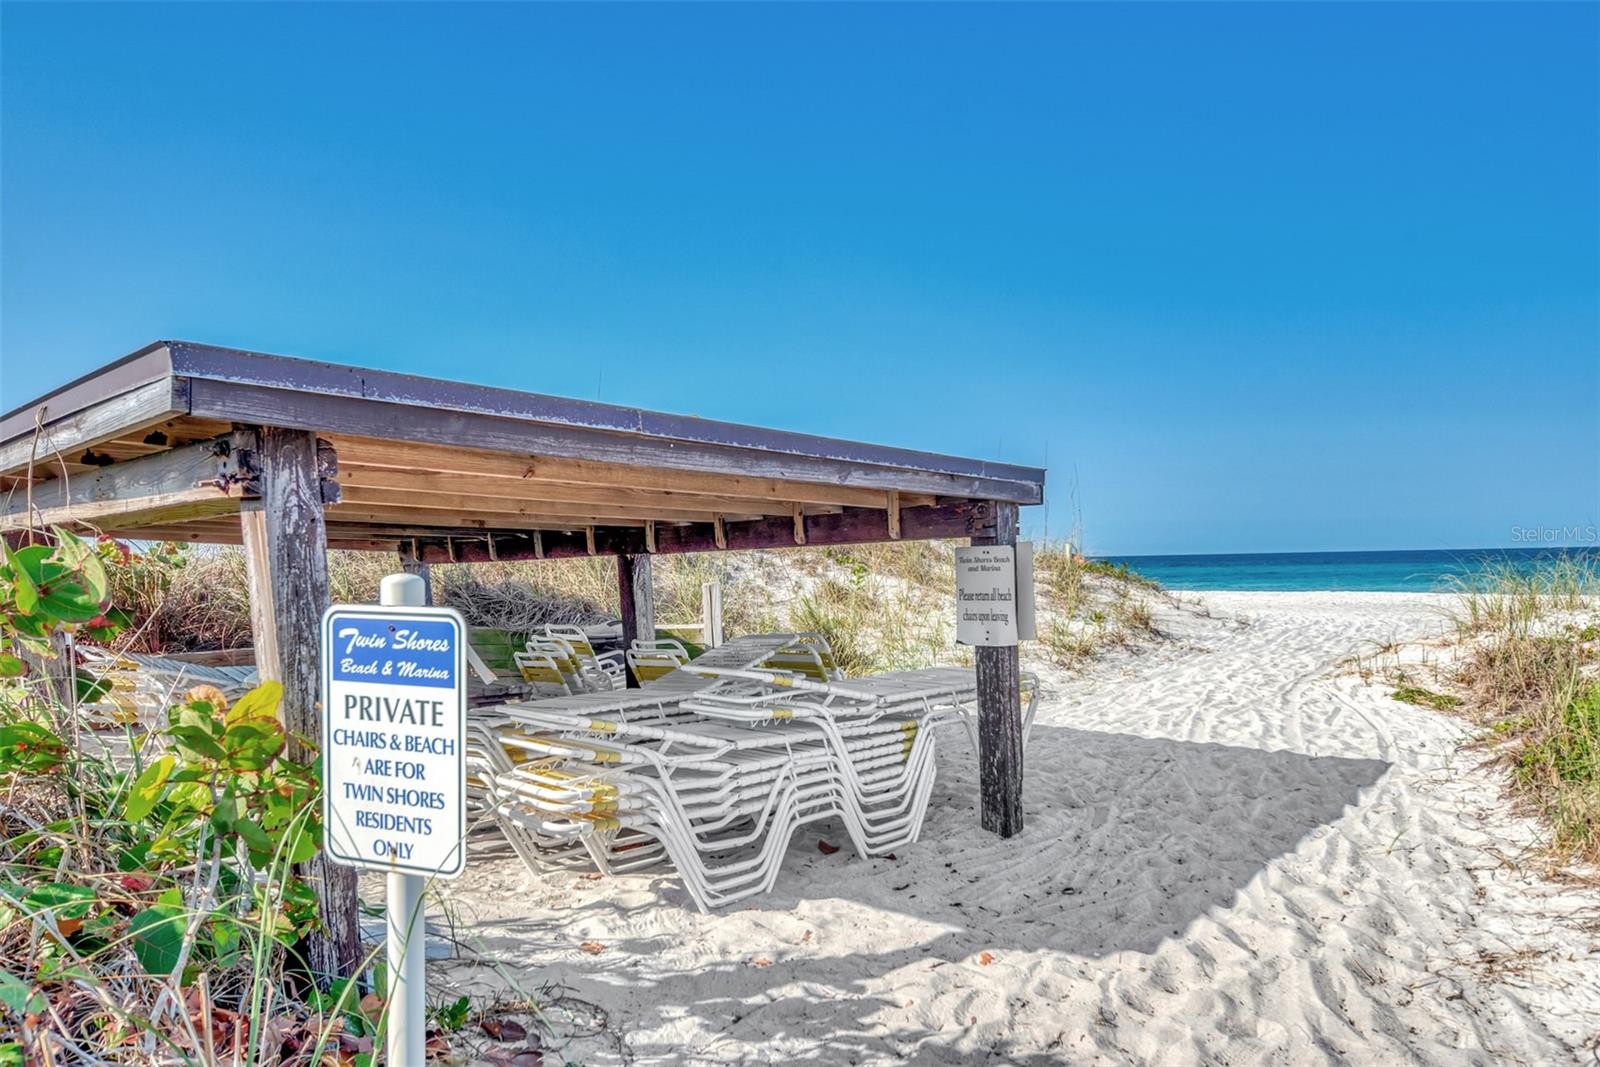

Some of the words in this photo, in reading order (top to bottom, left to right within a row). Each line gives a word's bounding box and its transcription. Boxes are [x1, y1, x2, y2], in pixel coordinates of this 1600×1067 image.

[959, 588, 974, 601] Please
[339, 628, 387, 654] Twin
[392, 630, 450, 652] Shores
[340, 658, 378, 676] Beach
[382, 661, 392, 676] &
[396, 661, 450, 680] Marina
[344, 694, 444, 727] PRIVATE
[333, 728, 387, 750] CHAIRS
[389, 735, 402, 751] &
[404, 735, 455, 756] BEACH
[364, 758, 393, 778] ARE
[394, 761, 426, 781] FOR
[343, 782, 384, 803] TWIN
[386, 788, 446, 810] SHORES
[355, 810, 433, 836] RESIDENTS
[373, 838, 415, 860] ONLY
